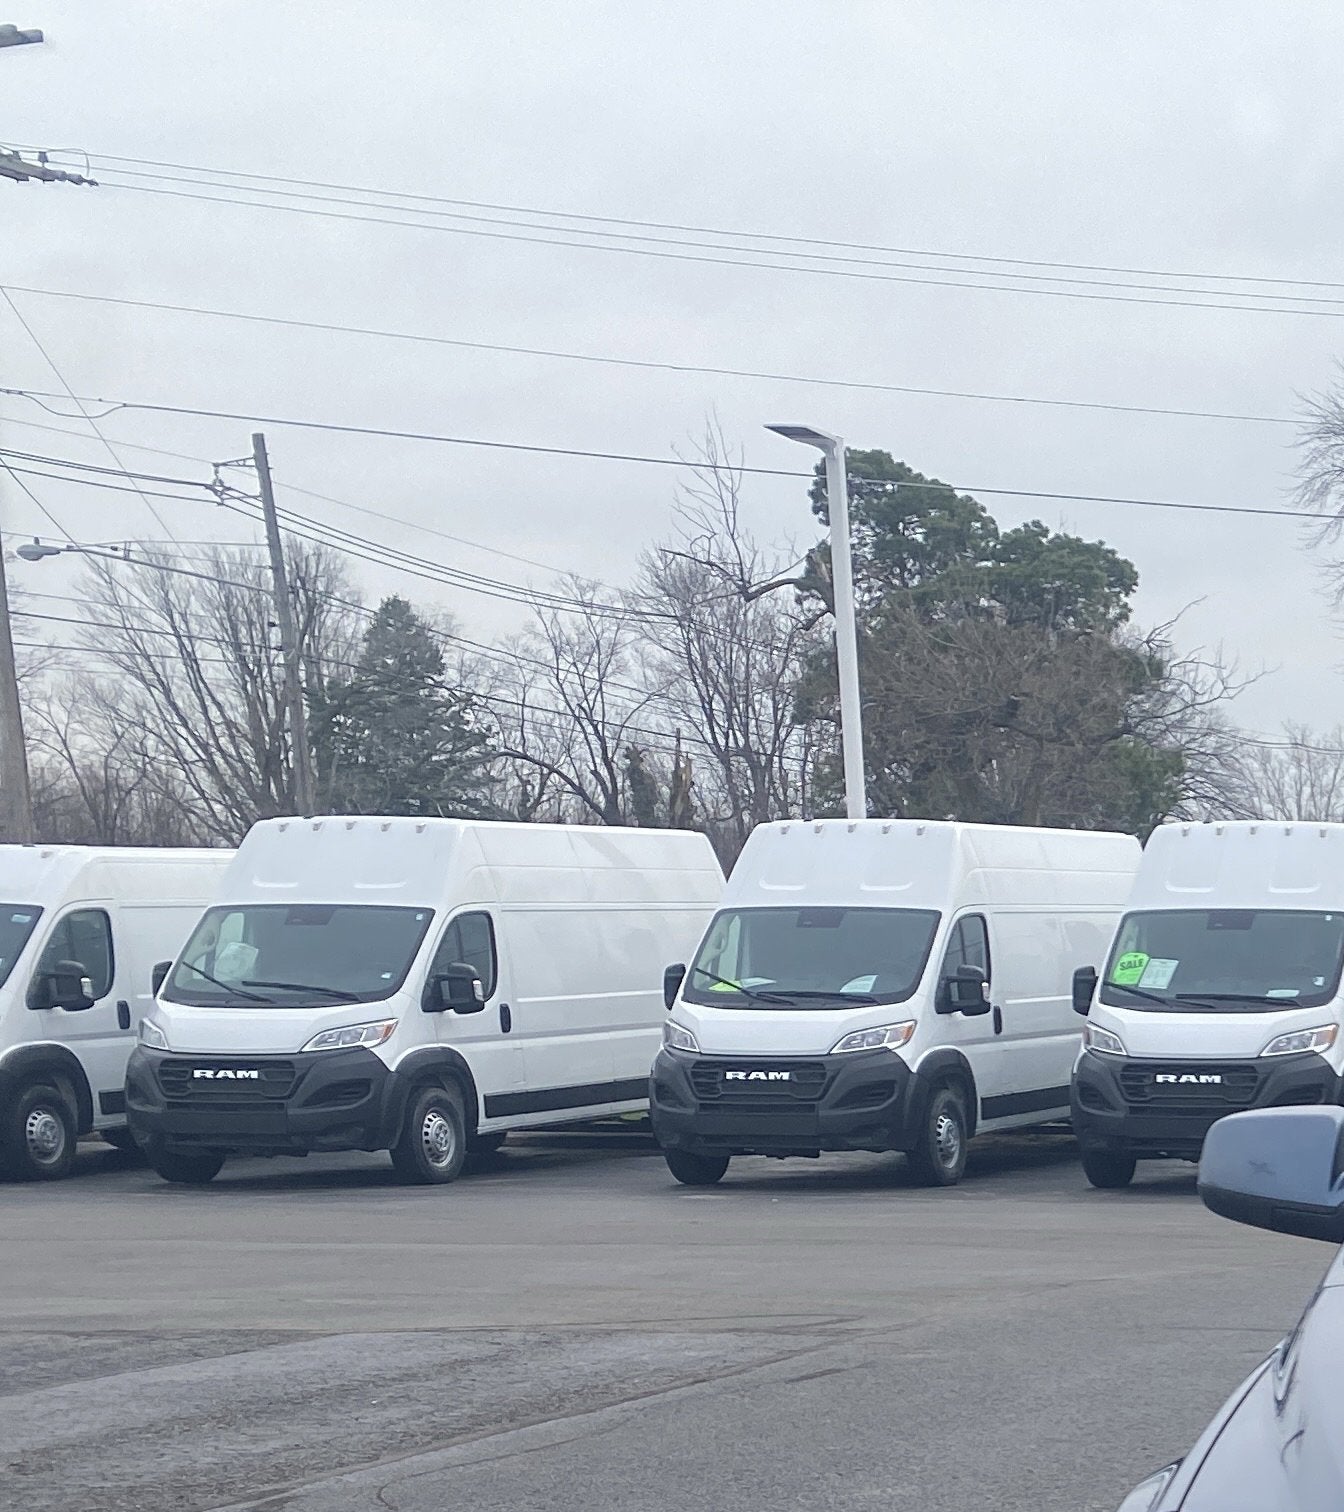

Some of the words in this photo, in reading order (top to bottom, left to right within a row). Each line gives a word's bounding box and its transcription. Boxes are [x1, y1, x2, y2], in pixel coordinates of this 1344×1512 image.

[1119, 958, 1144, 971] SALE
[193, 1069, 259, 1079] RAM
[725, 1071, 790, 1081] RAM
[1155, 1074, 1222, 1084] RAM
